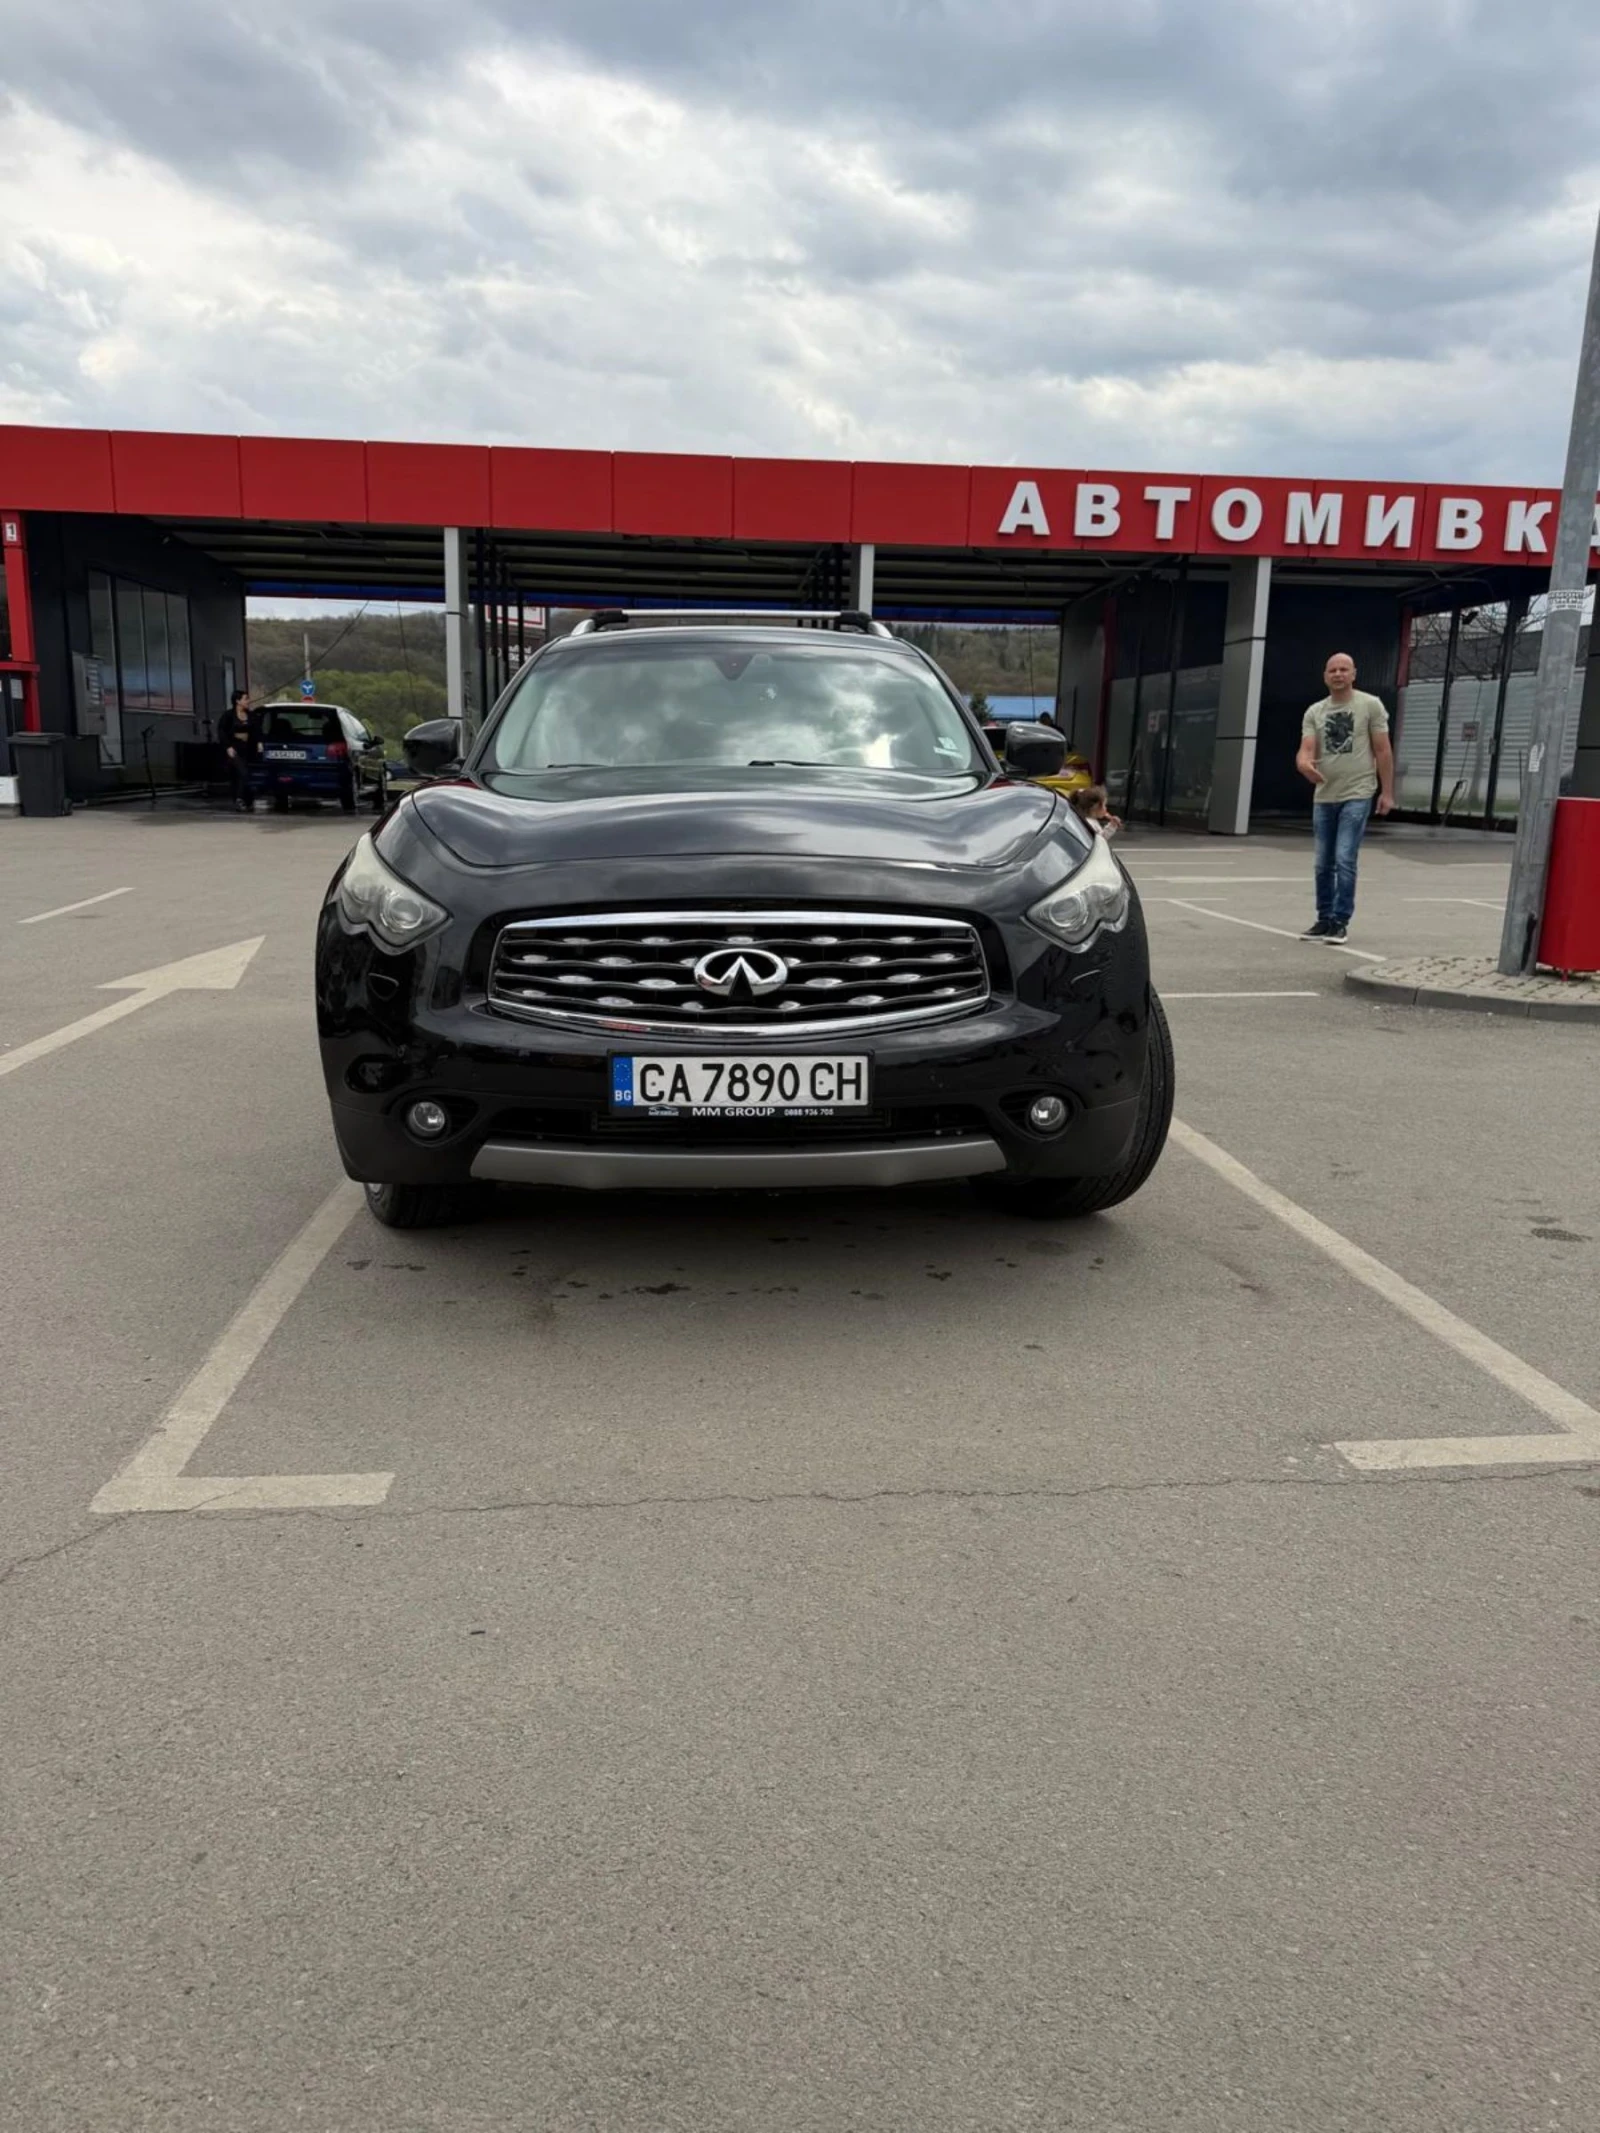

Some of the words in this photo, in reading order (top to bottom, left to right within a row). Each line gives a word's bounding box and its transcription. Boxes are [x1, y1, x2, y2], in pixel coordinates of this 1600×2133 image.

[998, 480, 1600, 554] АВТОМИВК
[639, 1063, 692, 1102] CA
[701, 1062, 801, 1102] 7890
[809, 1061, 862, 1101] CH
[614, 1089, 632, 1101] BG
[692, 1106, 721, 1117] MM
[724, 1106, 776, 1117] GROUP
